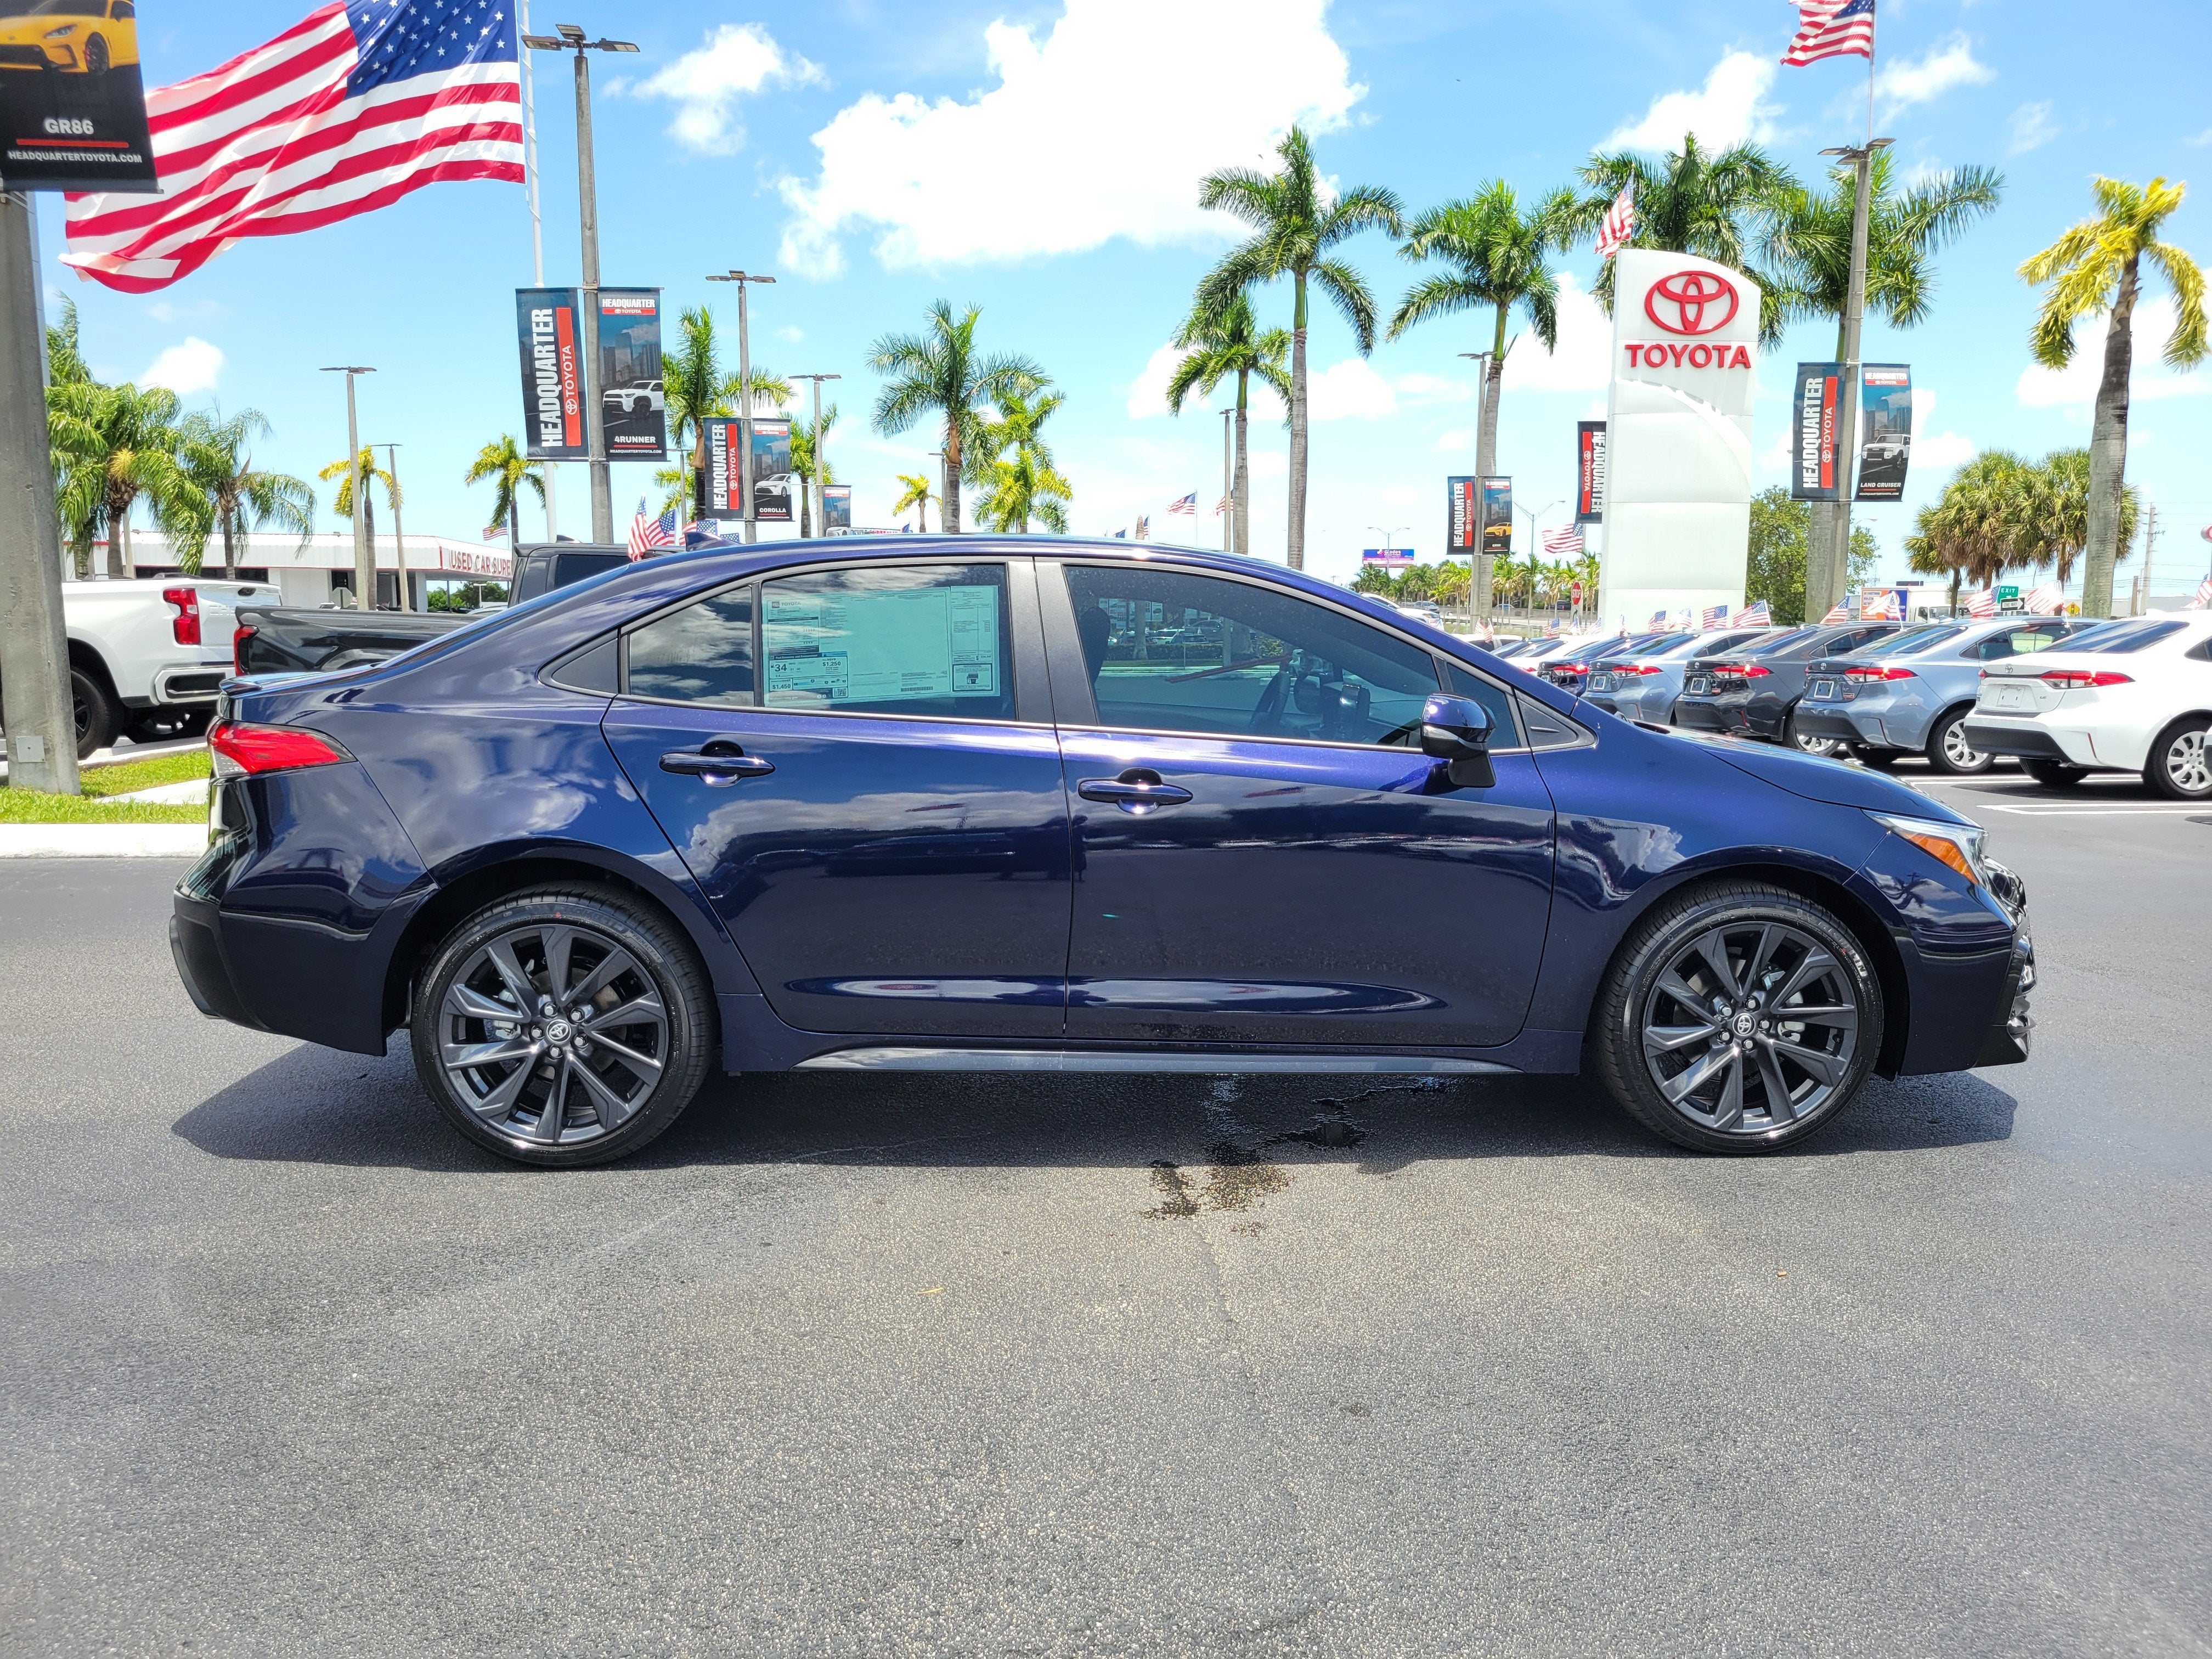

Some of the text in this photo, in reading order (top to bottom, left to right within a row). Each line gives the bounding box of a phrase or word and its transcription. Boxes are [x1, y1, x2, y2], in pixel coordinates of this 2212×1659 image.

[44, 119, 94, 135] GR86
[7, 150, 143, 163] HEADQUARTERTOYOTA.COM
[602, 298, 656, 308] HEADQUARTER
[562, 345, 575, 398] TOYOTA
[1624, 343, 1752, 369] TOYOTA
[531, 308, 563, 447] HEADQUARTER
[1802, 377, 1824, 488] HEADQUARTER
[1822, 407, 1833, 449] TOYOTA
[712, 424, 728, 510] HEADQUARTER
[1591, 431, 1606, 514] HEADQUARTER
[1453, 482, 1464, 547] HEADQUARTER
[451, 550, 512, 576] USED CAR SUPE
[1572, 589, 1582, 599] STOP
[774, 663, 788, 672] 34
